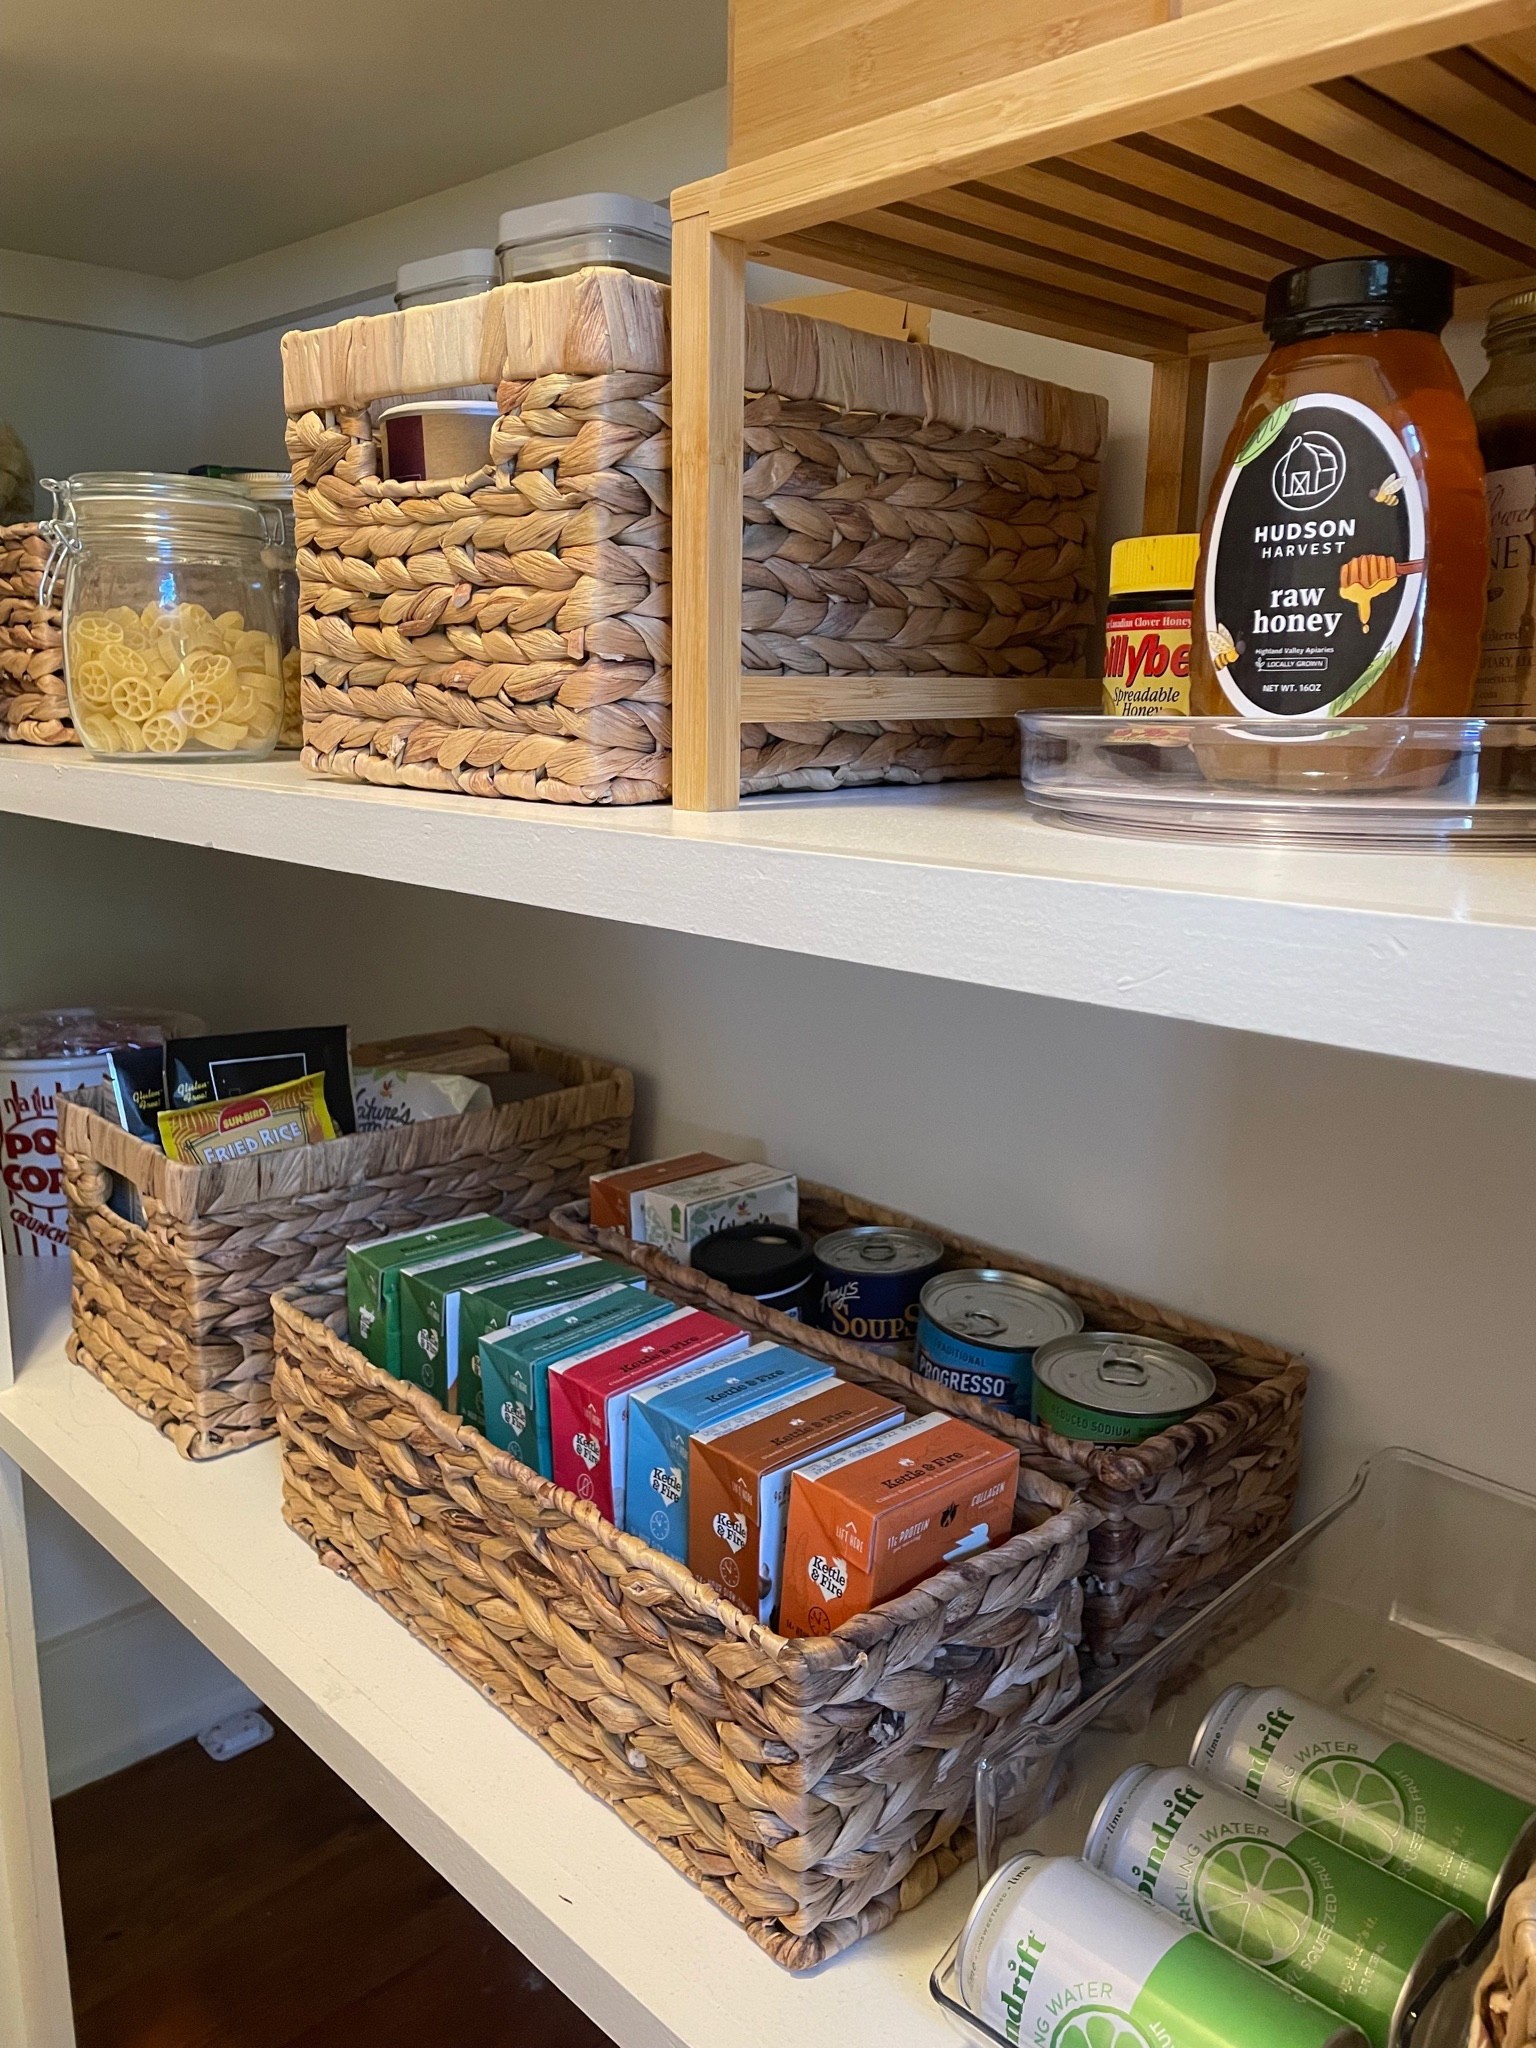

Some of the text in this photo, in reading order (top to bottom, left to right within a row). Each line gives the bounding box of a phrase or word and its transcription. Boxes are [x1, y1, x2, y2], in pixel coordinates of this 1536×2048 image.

[1254, 519, 1356, 543] HUDSON
[1262, 541, 1345, 559] HARVEST
[1270, 587, 1326, 608] raw
[1134, 617, 1161, 627] Clover
[1162, 617, 1192, 628] Honey
[1252, 609, 1343, 638] honey
[1103, 633, 1191, 688] illybe
[1255, 645, 1335, 656] Highland Valley Apiaries
[1266, 660, 1324, 669] LOCALLY GROWN
[1114, 687, 1180, 706] Spreadable
[1262, 683, 1322, 693] NET WT. 16OZ
[4, 1128, 58, 1160] PO
[203, 1120, 302, 1165] FRIED RICE
[3, 1163, 64, 1194] COR
[10, 1208, 70, 1246] CRUNCH
[820, 1280, 860, 1313] Amy's
[704, 1382, 748, 1403] Kettle
[757, 1369, 786, 1384] Fire
[917, 1354, 1005, 1397] PROGRESSO
[771, 1427, 814, 1448] Kettle
[824, 1409, 854, 1427] Fire
[1091, 1420, 1133, 1438] SODIUM
[575, 1434, 600, 1456] Kettle
[652, 1467, 682, 1492] Kettle
[881, 1451, 964, 1489] Kettle & Fire
[652, 1479, 681, 1504] & Fire
[970, 1481, 1006, 1508] COLLAGEN
[716, 1513, 747, 1539] Kettle
[716, 1523, 746, 1548] & Fire
[835, 1526, 864, 1554] LIFT HERE
[899, 1518, 931, 1543] PROTEIN
[811, 1568, 844, 1599] & Fire
[812, 1555, 846, 1587] Kettle
[1205, 1731, 1223, 1759] lime
[1236, 1706, 1295, 1799] ndrift
[1293, 1740, 1359, 1765] WATER
[1105, 1806, 1125, 1836] lime
[1198, 1821, 1270, 1844] WATER
[1395, 1770, 1427, 1880] SQUEEZED FRUIT
[1131, 1783, 1204, 1899] pindrift
[1007, 1864, 1031, 1885] lime
[1175, 1842, 1201, 1926] RKLING
[977, 1891, 1008, 1953] UNSWEETENED
[1300, 1856, 1338, 1972] SQUEEZED FRUIT
[1000, 1930, 1047, 2044] ndrift
[1045, 1981, 1113, 2017] WATER
